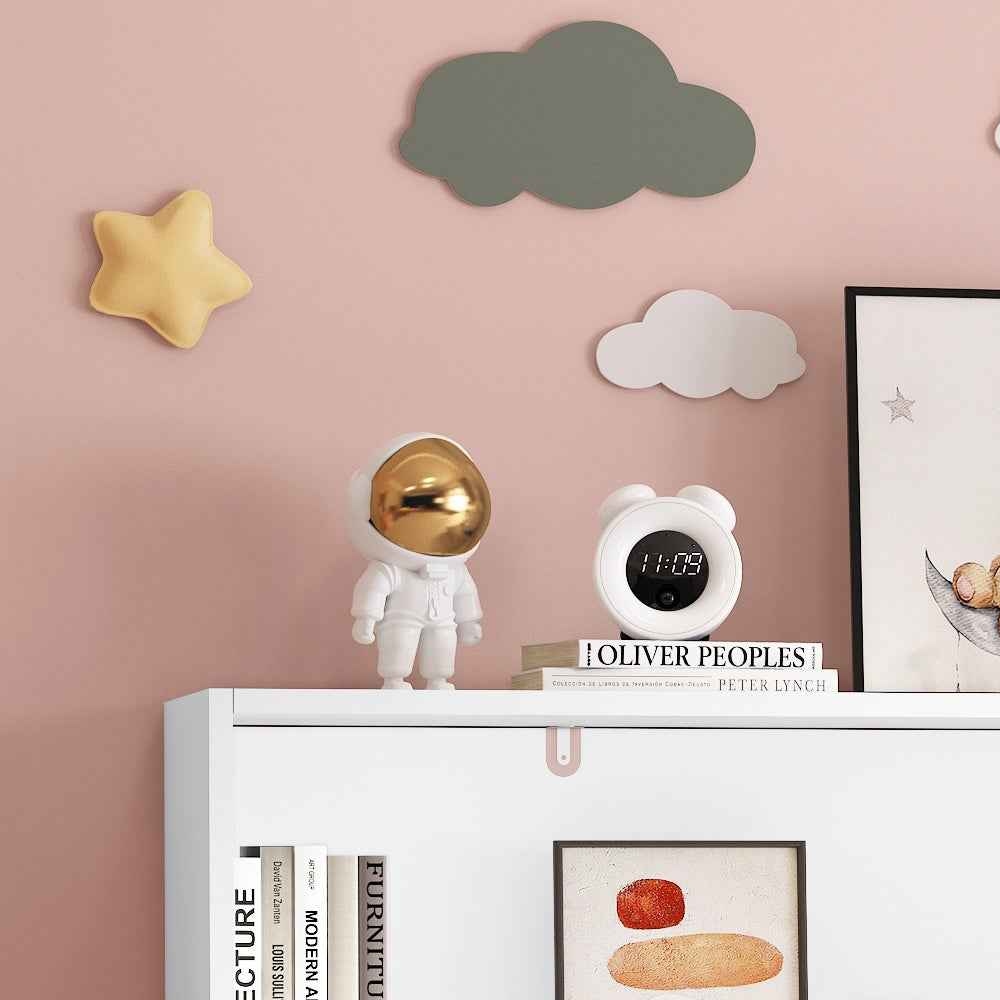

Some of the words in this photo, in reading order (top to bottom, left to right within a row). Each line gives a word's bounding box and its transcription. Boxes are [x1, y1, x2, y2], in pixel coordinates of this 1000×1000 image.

[641, 552, 703, 576] 11:09
[598, 644, 690, 668] OLIVER
[698, 646, 806, 669] PEOPLES
[718, 678, 769, 692] PETER
[775, 679, 826, 693] LYNCH
[272, 860, 283, 882] David
[272, 883, 283, 897] Van
[272, 898, 283, 924] Zanten
[272, 944, 285, 972] LOUIS
[305, 910, 319, 982] MODERN
